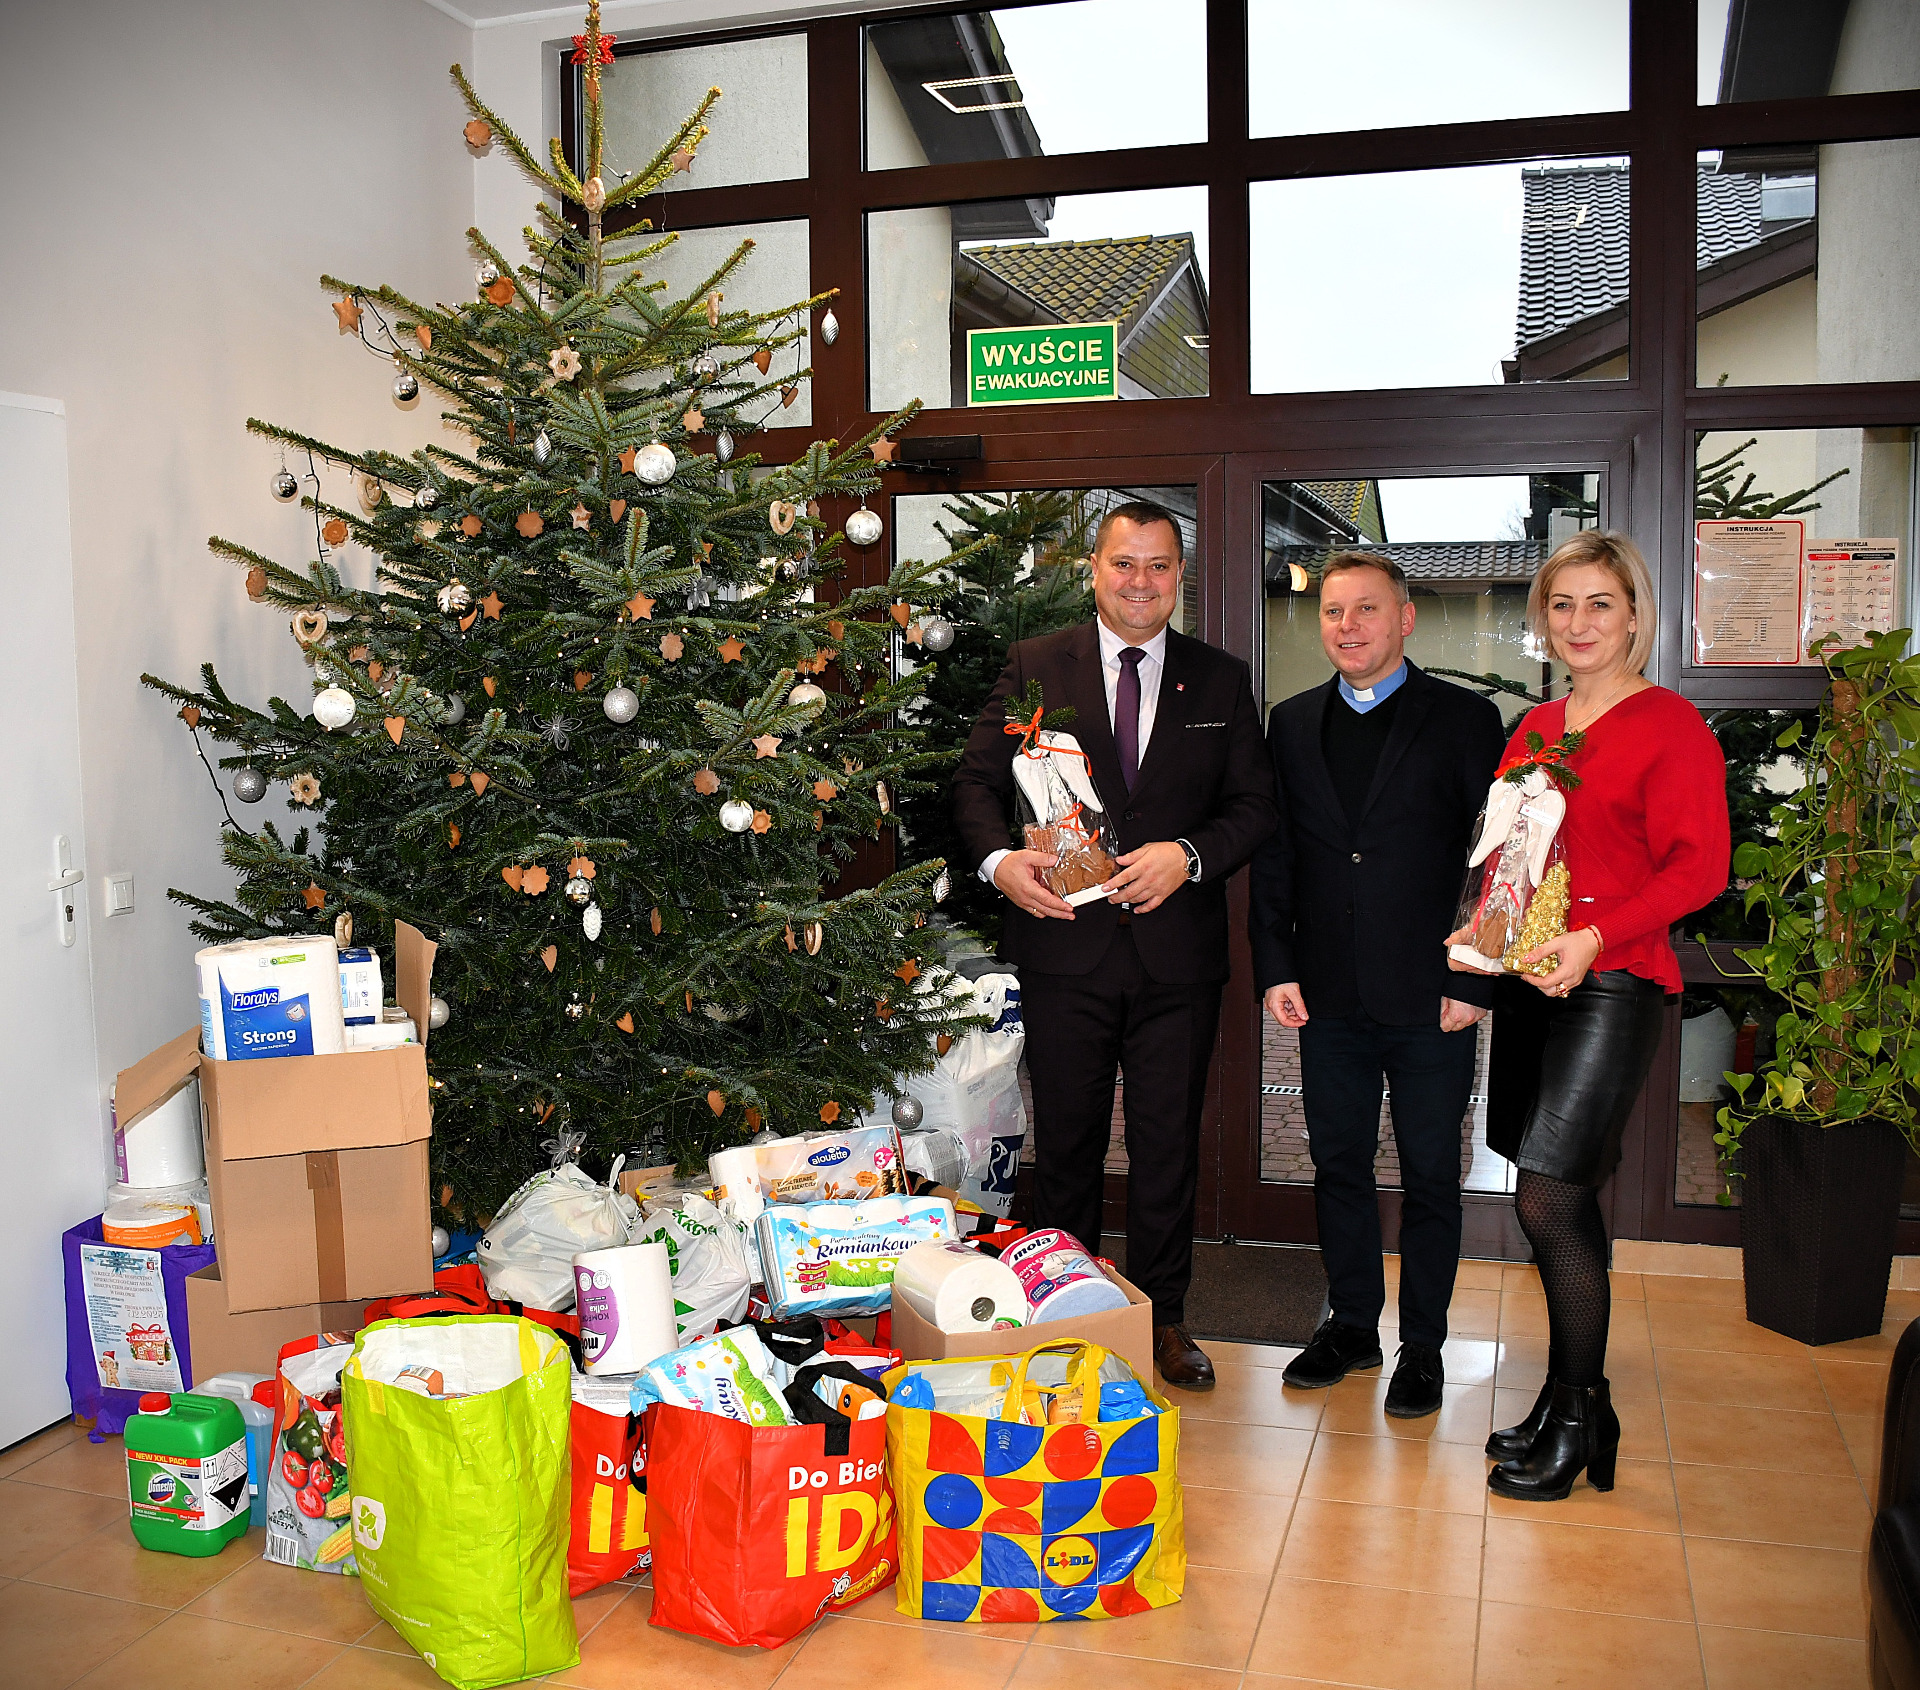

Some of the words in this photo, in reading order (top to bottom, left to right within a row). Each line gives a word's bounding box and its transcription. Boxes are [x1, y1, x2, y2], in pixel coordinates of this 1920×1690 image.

[981, 336, 1103, 367] WYJŚCIE
[975, 368, 1110, 391] EWAKUACYJNE
[233, 991, 279, 1008] Floralys
[242, 1028, 297, 1045] Strong
[811, 1149, 849, 1166] alouette
[816, 1237, 923, 1260] Rumiankow
[1013, 1235, 1052, 1261] mola
[1017, 1256, 1046, 1279] OMPLEX
[589, 1304, 609, 1314] rolka
[135, 1452, 153, 1462] NEW
[154, 1454, 168, 1464] XXL
[168, 1456, 188, 1466] PACK
[596, 1453, 627, 1480] Do
[149, 1479, 176, 1493] Domestos
[788, 1466, 829, 1491] Do
